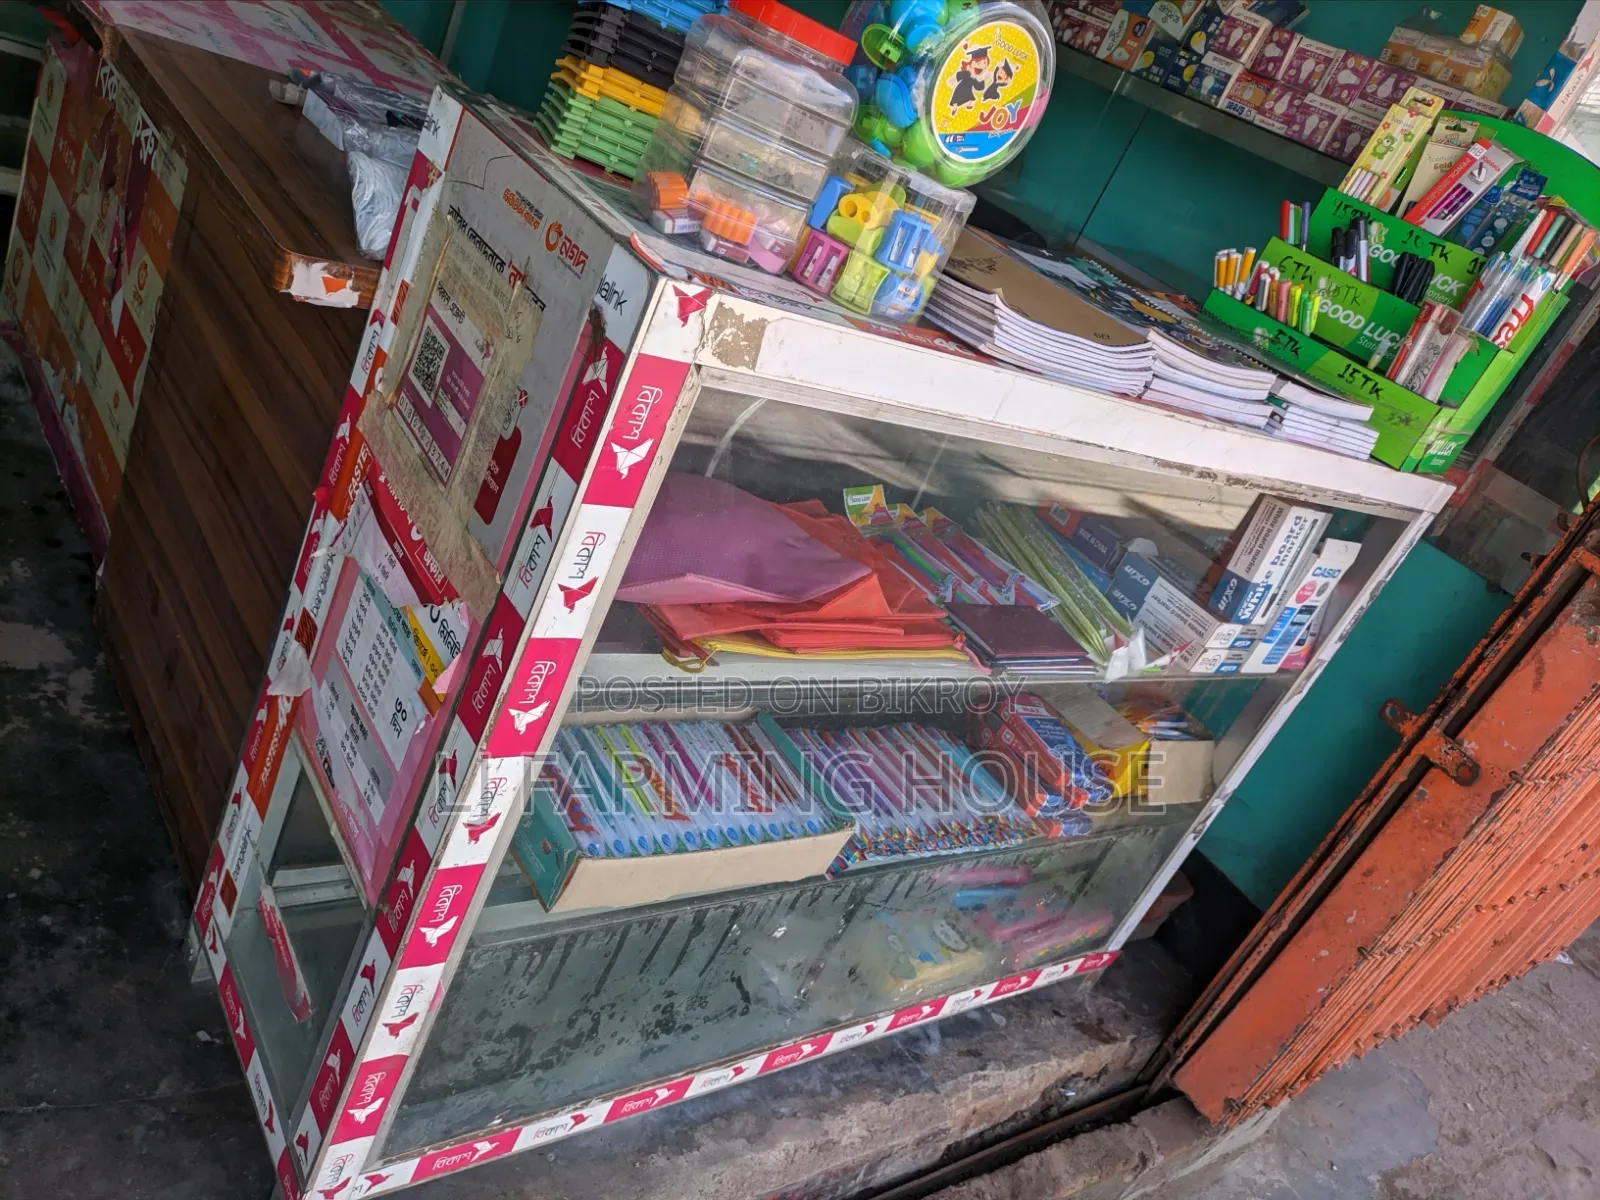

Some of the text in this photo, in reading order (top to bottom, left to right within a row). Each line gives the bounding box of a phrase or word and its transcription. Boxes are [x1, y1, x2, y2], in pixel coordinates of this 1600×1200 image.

[979, 98, 1022, 129] JOY
[1433, 161, 1453, 170] Gold
[1450, 157, 1472, 179] PENCIL
[1469, 145, 1484, 157] HB
[560, 235, 590, 272] নগদ
[1319, 299, 1365, 331] GOOD
[571, 389, 600, 449] বিকাশ
[623, 385, 663, 440] বিকাশ
[346, 442, 375, 501] FASTE
[568, 531, 606, 579] বিকাশ
[1243, 506, 1284, 574] White board marker
[1279, 517, 1309, 567] marker
[421, 549, 446, 586] অফার
[519, 534, 546, 589] বিকাশ
[1240, 515, 1303, 620] White board
[1312, 566, 1341, 578] CASIO
[310, 550, 337, 618] banglalink
[1150, 593, 1205, 638] White board marker
[472, 663, 496, 715] বিকাশ
[519, 660, 556, 704] বিকাশ
[389, 708, 403, 742] দিন
[393, 694, 407, 726] ৩০
[430, 883, 463, 923] বিকাশ
[352, 986, 369, 1027] বিকাশ
[392, 984, 423, 1018] বিকাশ
[773, 1050, 800, 1067] বিকাশ
[319, 1073, 337, 1112] বিকাশ
[359, 1071, 387, 1105] বিকাশ
[620, 1096, 653, 1115] বিকাশ
[532, 1120, 568, 1140] বিকাশ
[326, 1153, 354, 1185] বিকাশ
[432, 1149, 473, 1171] বিকাশ
